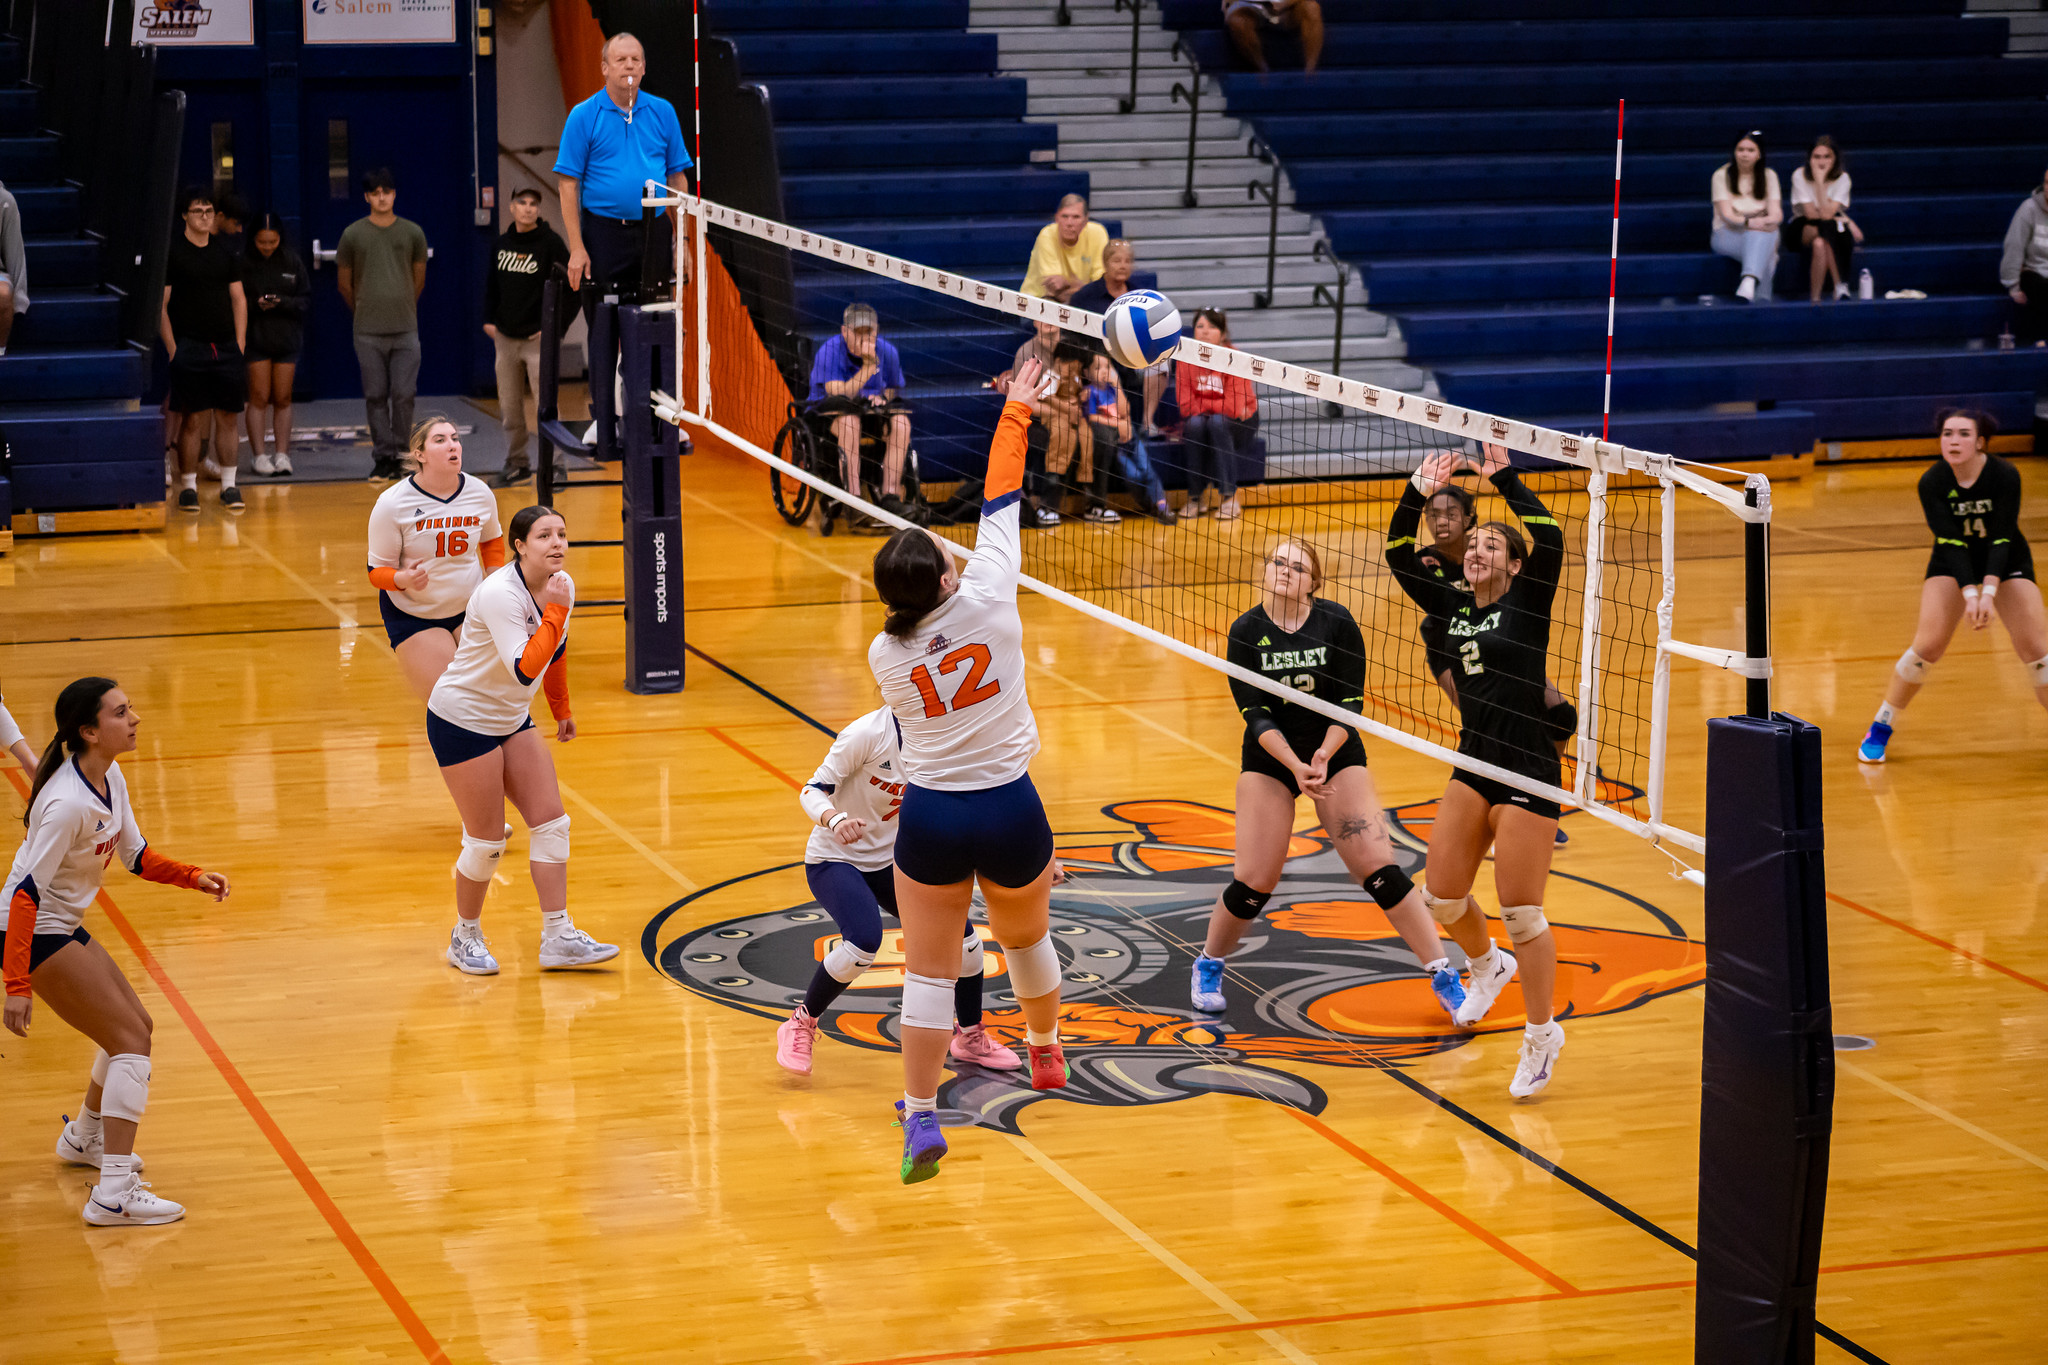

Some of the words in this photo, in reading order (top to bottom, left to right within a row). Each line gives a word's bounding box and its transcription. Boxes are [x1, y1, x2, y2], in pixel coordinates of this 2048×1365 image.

[140, 7, 212, 28] SALEM
[335, 0, 392, 14] Salem
[416, 516, 481, 532] VIKINGS
[1963, 518, 1987, 538] 14
[435, 530, 469, 558] 16
[653, 532, 667, 573] sports
[1261, 647, 1327, 671] LESLEY
[1459, 640, 1484, 675] 2
[910, 643, 1001, 719] 12
